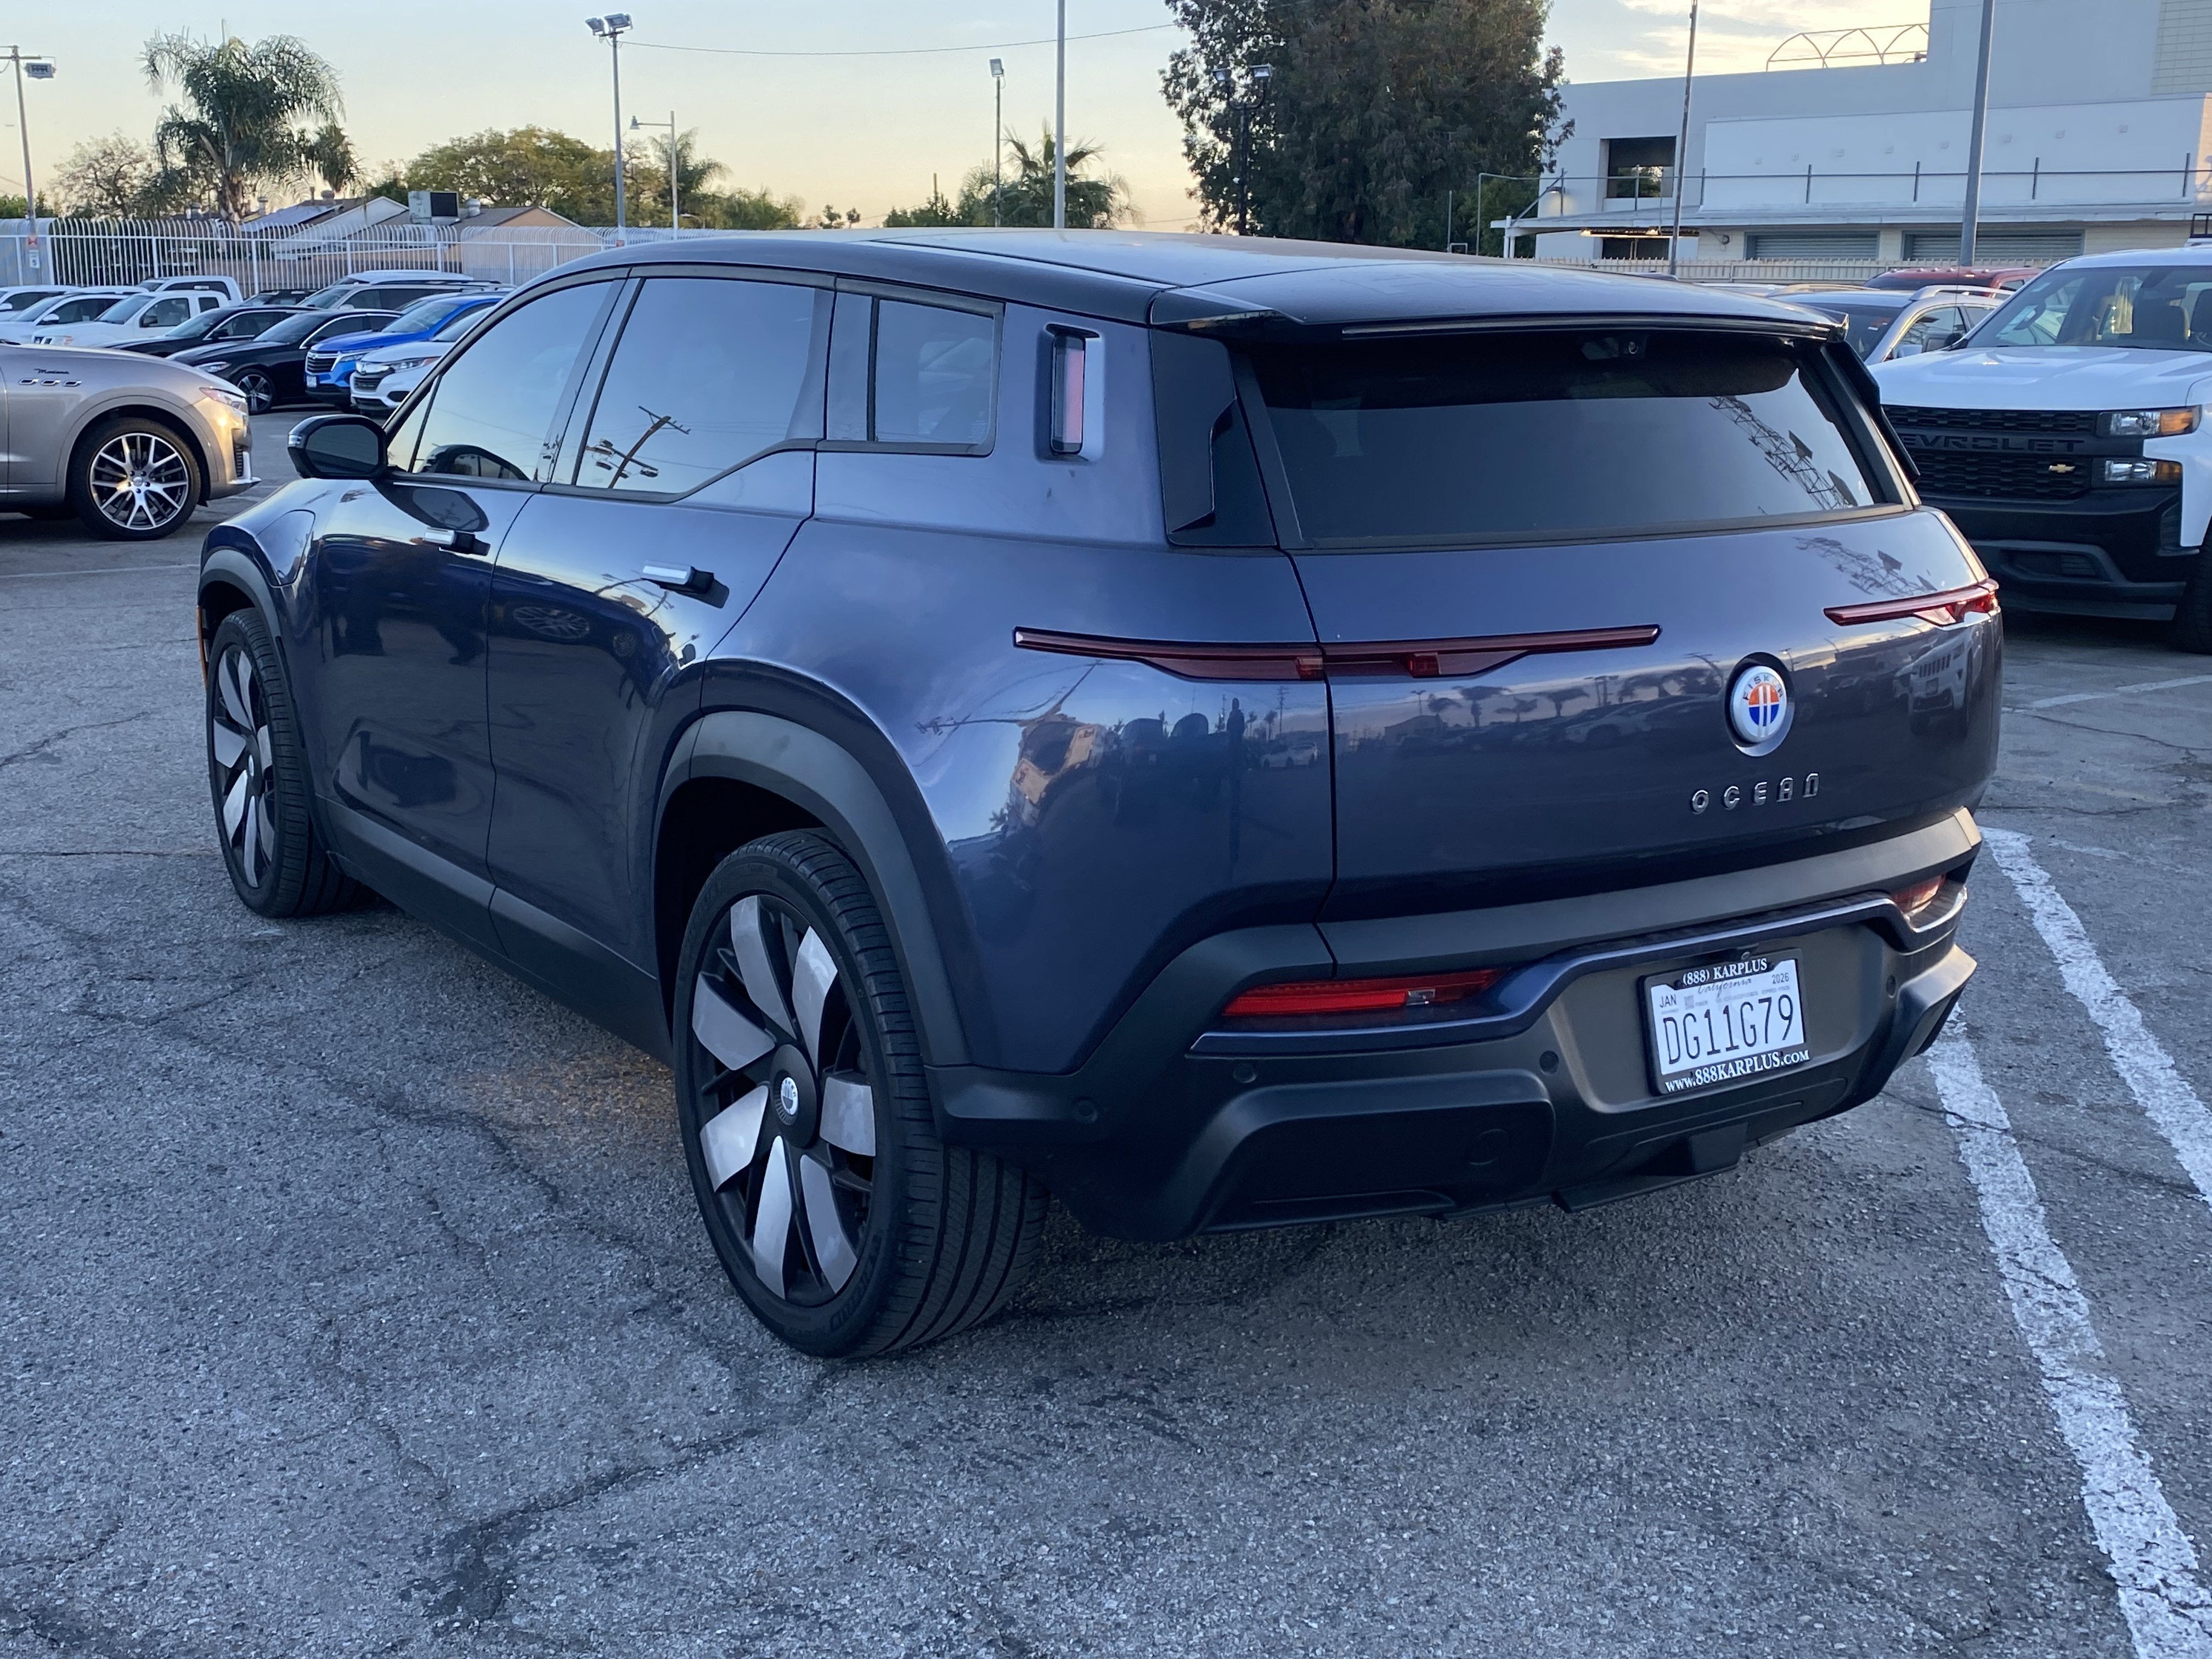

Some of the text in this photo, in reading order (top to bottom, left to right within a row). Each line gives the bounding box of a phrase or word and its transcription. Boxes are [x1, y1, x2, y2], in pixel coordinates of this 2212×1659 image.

[1898, 432, 2085, 453] EVROLET
[1742, 674, 1783, 701] FISKR
[1690, 772, 1819, 815] OCEAN
[1682, 958, 1768, 986] (888) KARPLUS
[1771, 972, 1790, 985] 2026
[1660, 994, 1677, 1008] JAN
[1663, 994, 1794, 1065] DG11G79
